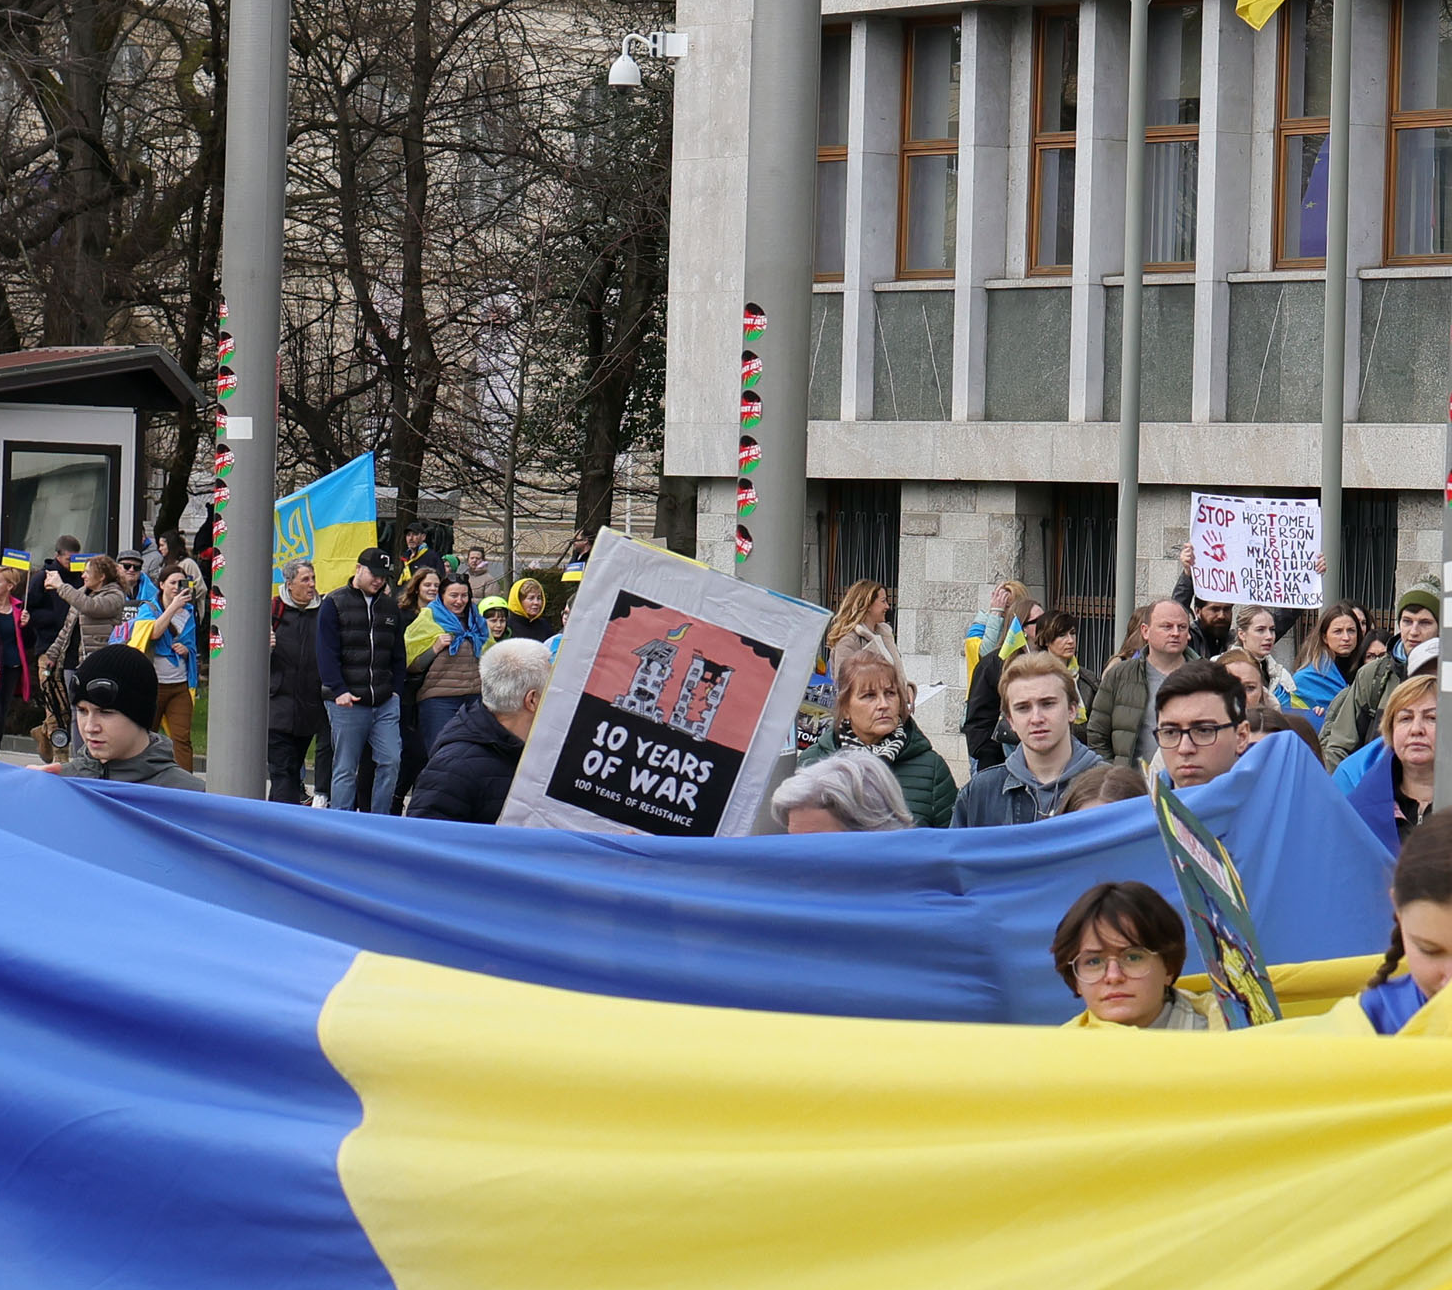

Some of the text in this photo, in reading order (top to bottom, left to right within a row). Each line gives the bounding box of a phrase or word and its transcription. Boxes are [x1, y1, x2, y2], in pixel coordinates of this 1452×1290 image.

[1197, 504, 1236, 527] STOP
[1242, 511, 1314, 528] HOSTOMEL
[1251, 526, 1314, 540] KHERSON
[1263, 538, 1306, 550] IRPIN
[1247, 546, 1315, 560] MYKOLAIV
[1192, 567, 1238, 593] RUSSIA
[1240, 568, 1311, 584] OLENIVKA
[1242, 579, 1300, 593] POPASNA
[1249, 590, 1324, 606] KRAMATORSK
[592, 720, 715, 784] 10 YEARS
[582, 749, 699, 812] OF WAR
[574, 778, 694, 827] 100 YEARS OF RESISTANCE
